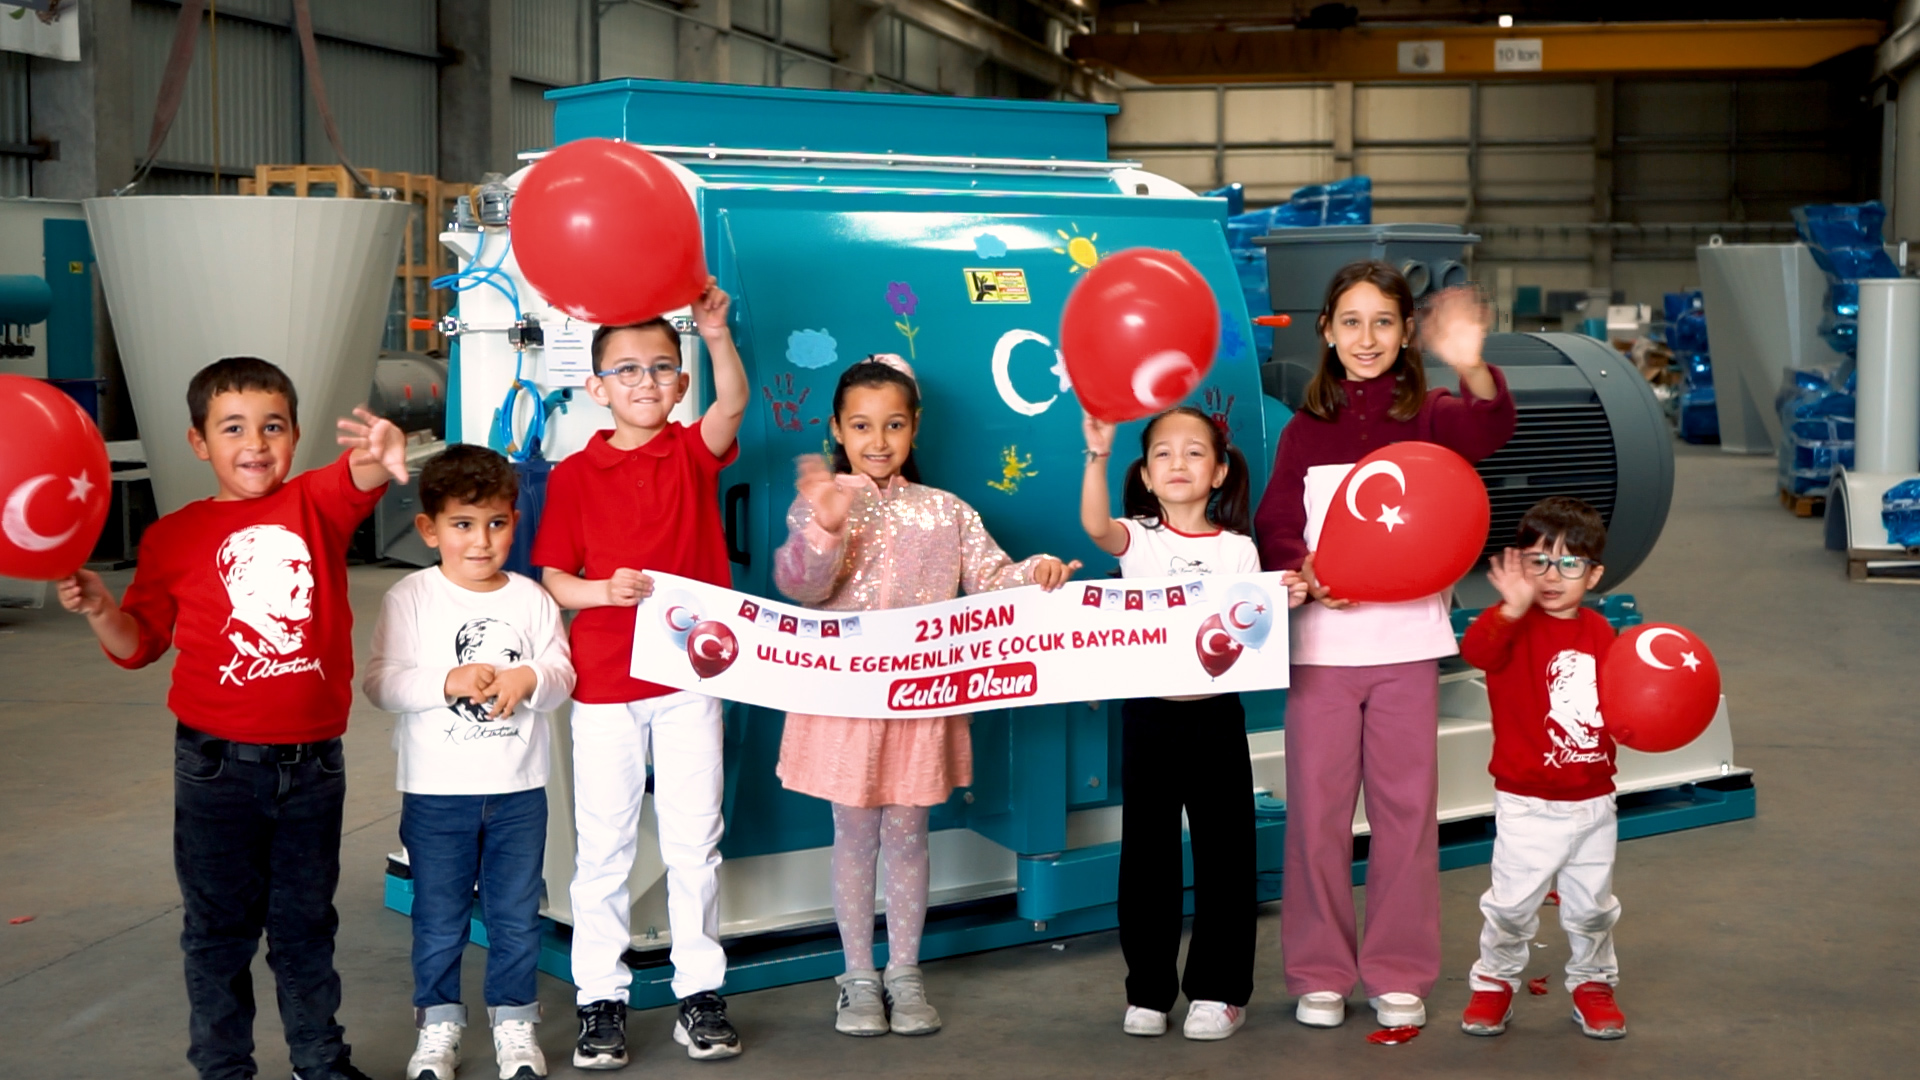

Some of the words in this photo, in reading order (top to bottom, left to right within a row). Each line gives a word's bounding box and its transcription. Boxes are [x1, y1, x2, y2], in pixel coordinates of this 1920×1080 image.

[1498, 47, 1515, 62] 10
[1518, 47, 1540, 61] ton
[915, 617, 944, 643] 23
[950, 604, 1014, 636] NİSAN
[757, 644, 842, 671] ULUSAL
[850, 643, 964, 672] EGEMENLİK
[970, 640, 993, 660] VE
[998, 632, 1065, 661] ÇOCUK
[1072, 627, 1167, 649] BAYRAMI
[891, 675, 959, 707] Kutlu
[967, 668, 1033, 699] Olsun
